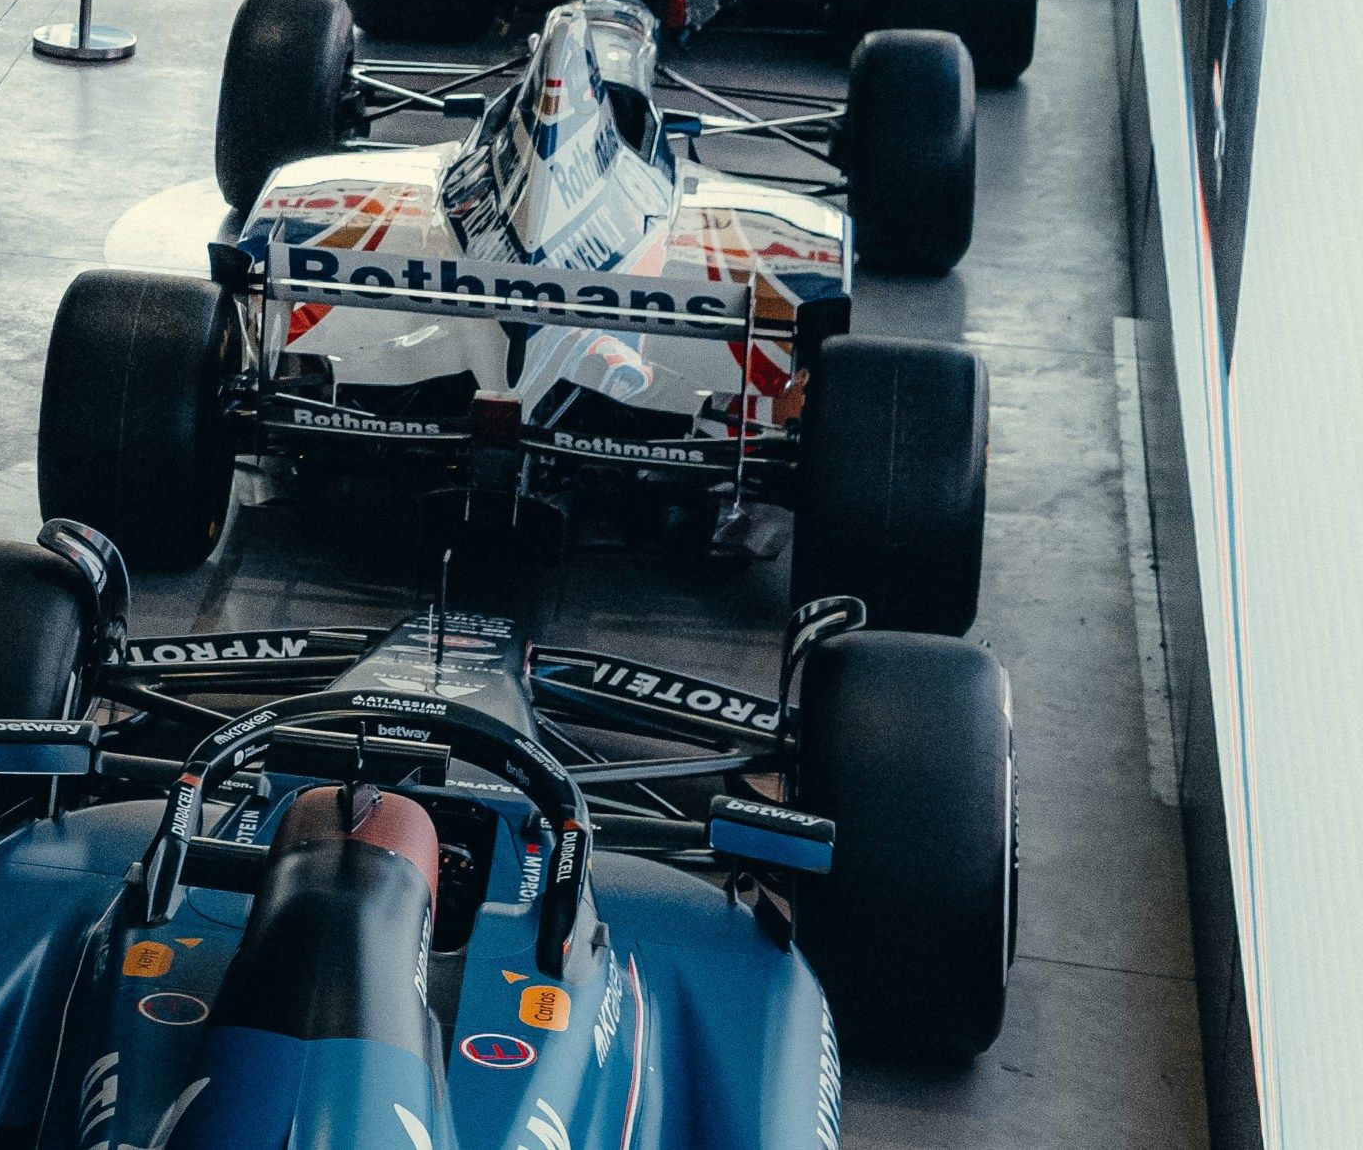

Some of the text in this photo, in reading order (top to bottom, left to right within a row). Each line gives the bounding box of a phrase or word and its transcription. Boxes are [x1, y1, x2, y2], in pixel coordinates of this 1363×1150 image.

[288, 246, 727, 330] Rothmans
[292, 408, 440, 435] Rothmans
[552, 430, 705, 463] Rothmans
[128, 635, 308, 664] MYPROT
[363, 695, 447, 712] ATLASSIAN
[224, 710, 279, 742] kraken
[377, 723, 431, 742] betway
[171, 785, 196, 838] DURACELL
[725, 799, 826, 827] betway
[555, 830, 579, 884] DURACELL
[534, 991, 556, 1023] Carlos
